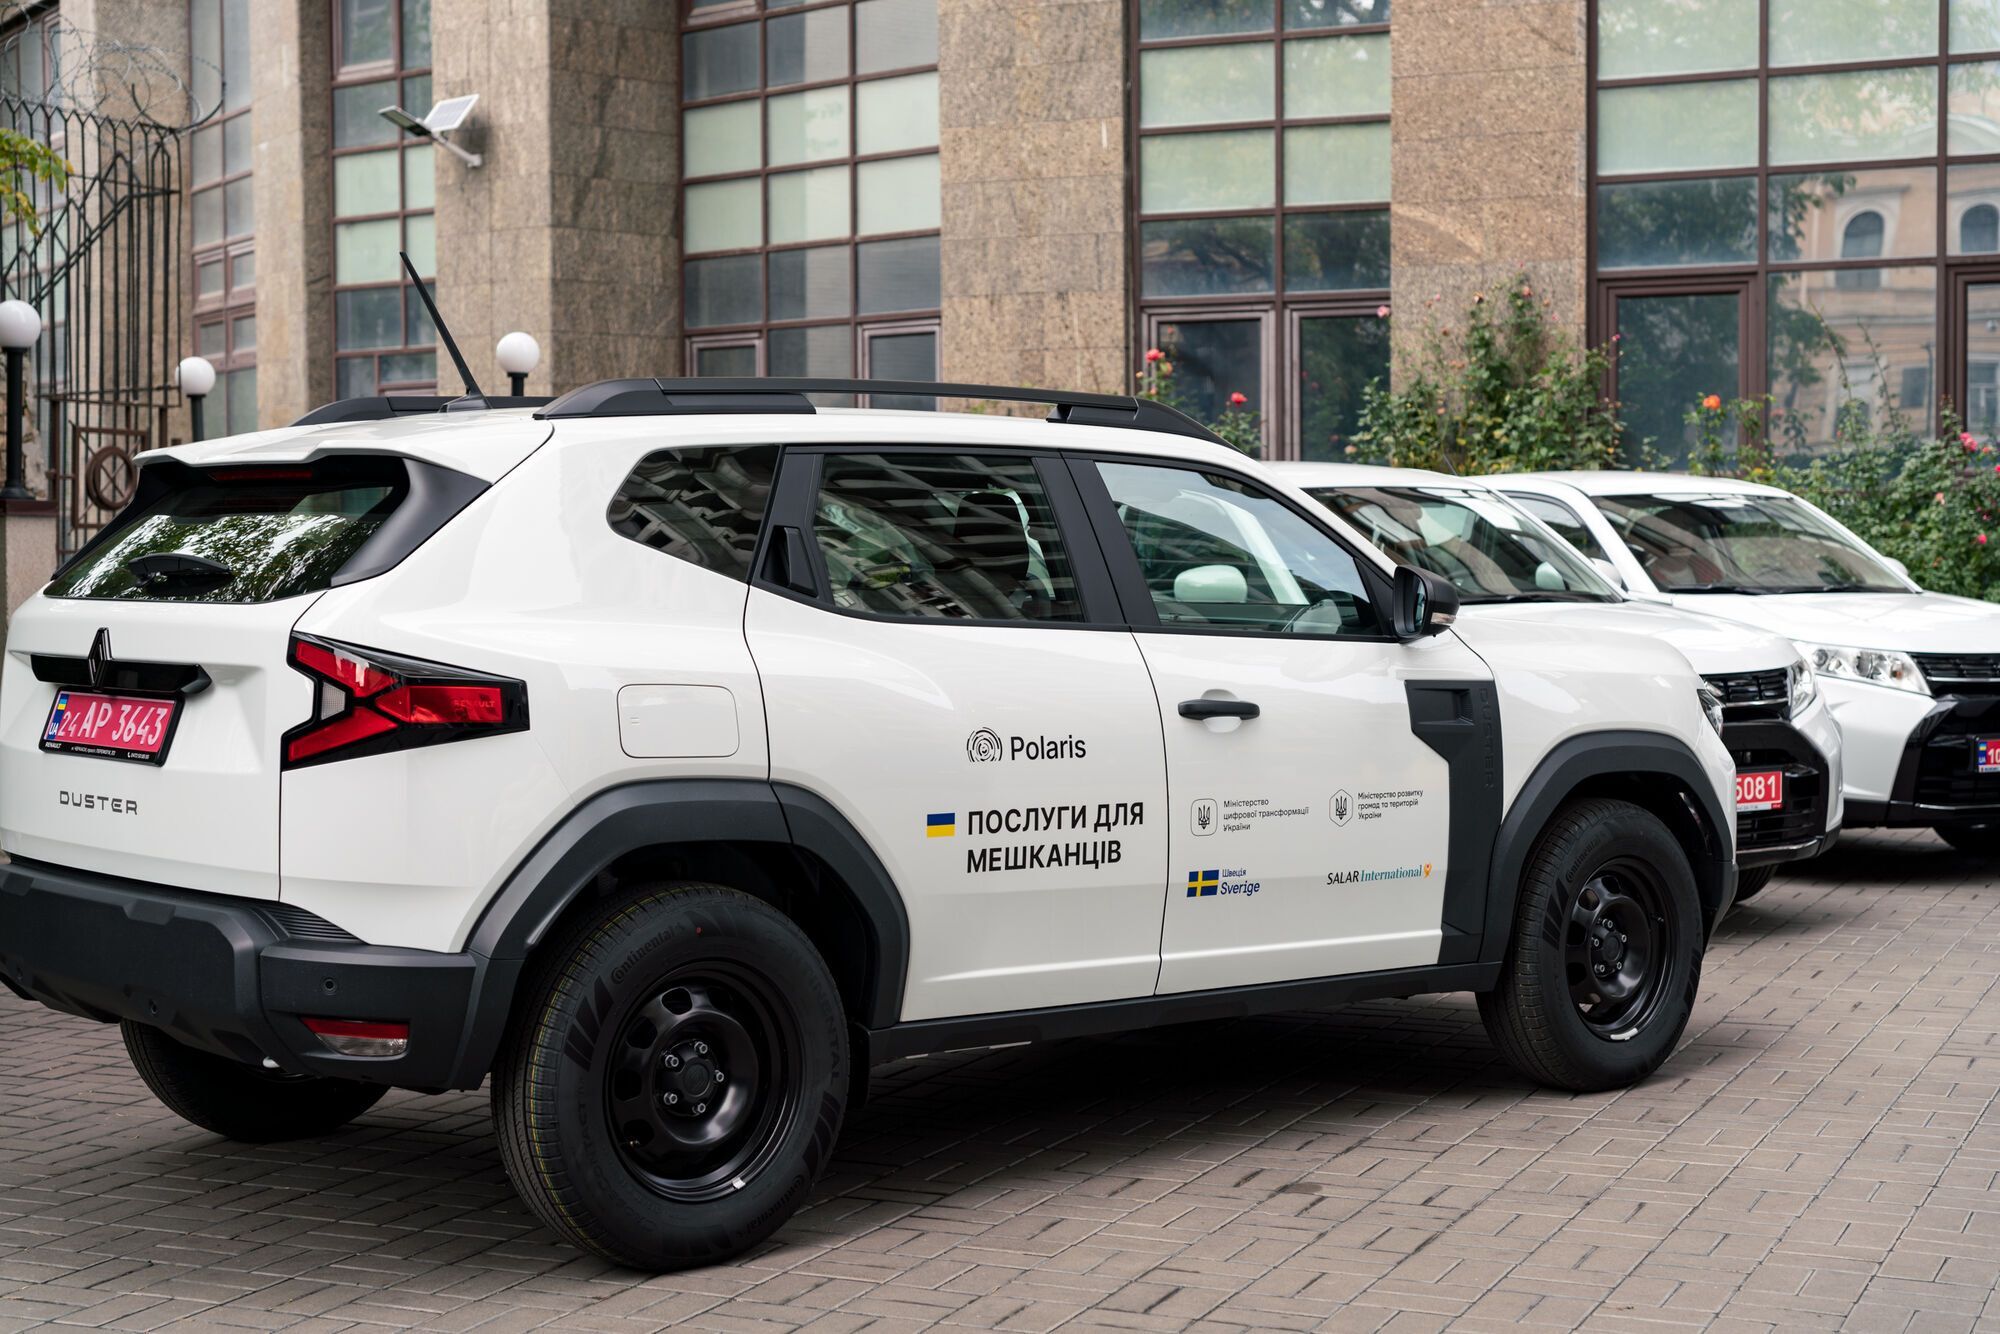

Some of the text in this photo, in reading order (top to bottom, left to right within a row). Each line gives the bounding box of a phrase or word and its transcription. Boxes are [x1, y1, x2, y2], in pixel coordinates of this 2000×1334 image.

[49, 722, 59, 736] UA
[58, 701, 168, 746] 24 AP 3643
[1010, 734, 1087, 761] Polaris
[59, 790, 138, 815] DUSTER
[1358, 790, 1424, 800] Міністерство розвитку
[1223, 799, 1270, 808] Міністерство
[1358, 802, 1380, 811] громад
[1389, 799, 1419, 809] територій
[967, 802, 1144, 835] ПОСЛУГИ ДЛЯ
[1223, 807, 1309, 820] цифрової трансформації
[1358, 811, 1382, 821] України
[1223, 823, 1251, 832] України
[967, 839, 1122, 873] МЕШКАНЦІВ
[1222, 868, 1247, 878] Швеція
[1326, 864, 1422, 885] SALAR International
[1220, 880, 1260, 896] Sverige
[611, 925, 674, 984] Continental
